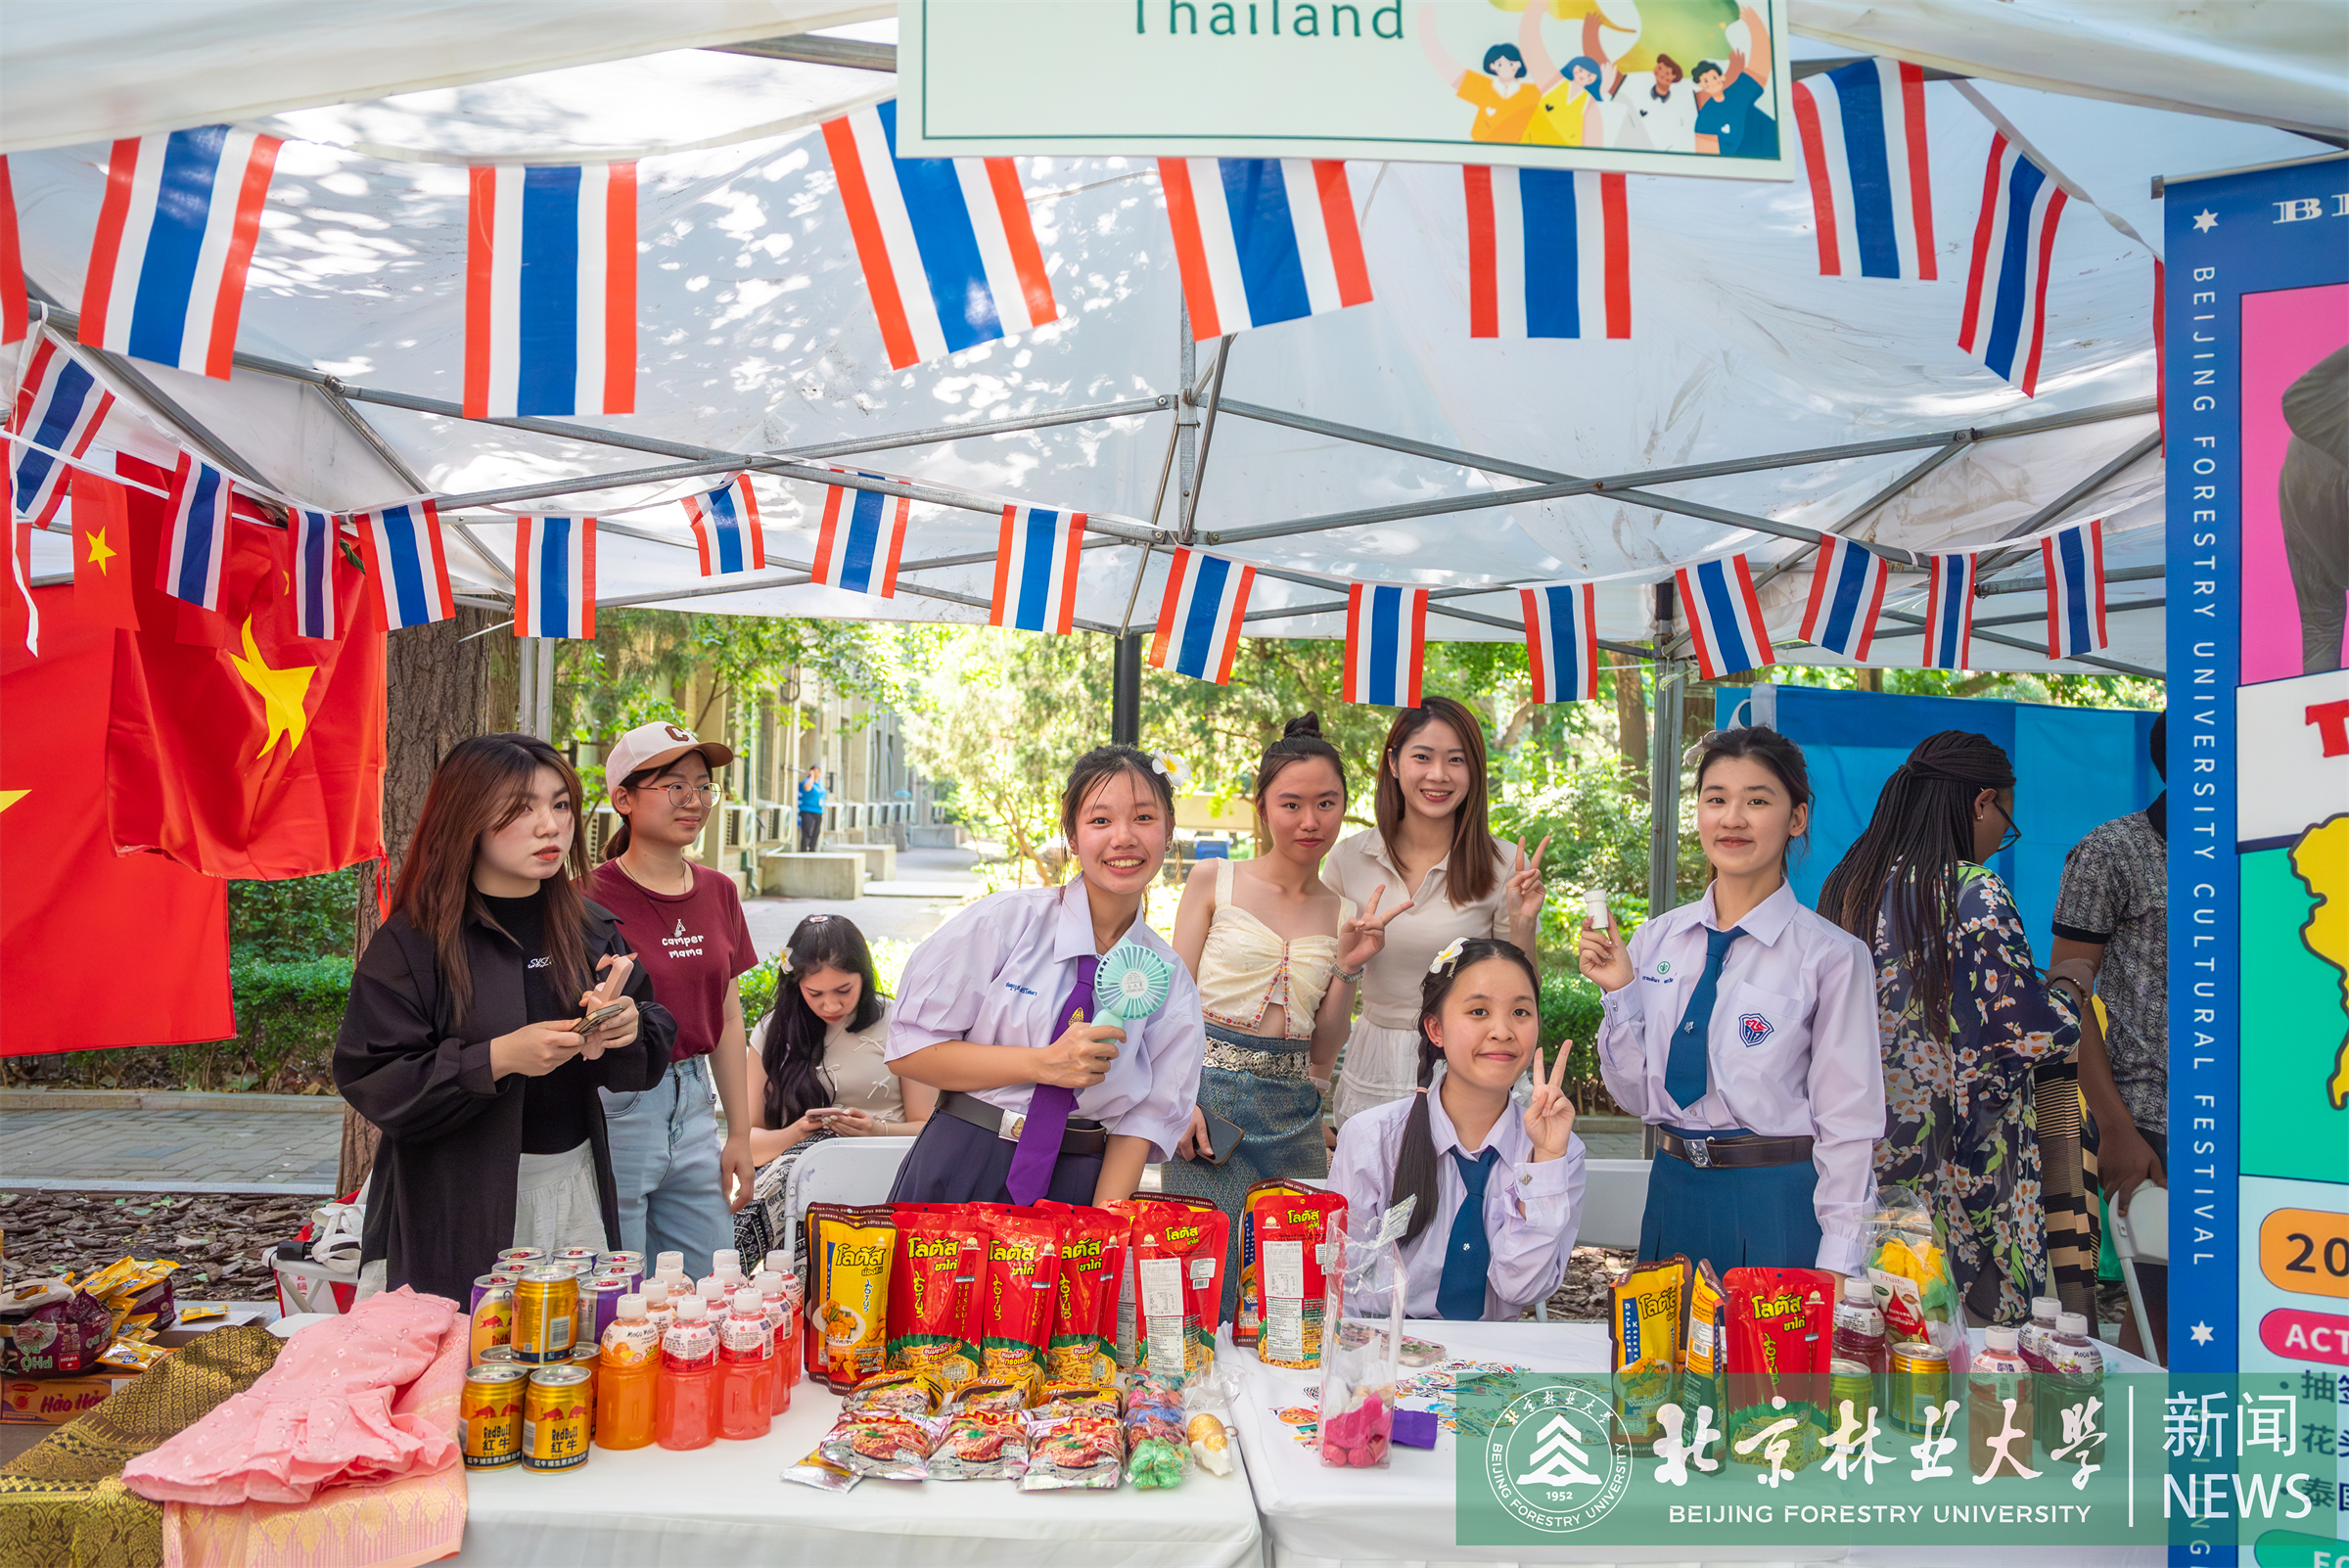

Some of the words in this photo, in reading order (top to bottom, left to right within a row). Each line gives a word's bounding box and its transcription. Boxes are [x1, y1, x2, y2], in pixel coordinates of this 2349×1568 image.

[2192, 266, 2215, 411] BEIJING
[2192, 437, 2215, 619] FORESTRY
[2192, 642, 2215, 860] UNIVERSITY
[662, 935, 705, 946] camper
[668, 947, 703, 959] mama
[2192, 883, 2215, 1070] CULTURAL
[2192, 1095, 2215, 1266] FESTIVAL
[1287, 1208, 1321, 1225] โลตัส
[1165, 1224, 1200, 1243] โลตัส
[836, 1243, 887, 1268] โลตัส
[907, 1236, 960, 1260] โลตัส
[989, 1239, 1038, 1262] โลตัส
[1061, 1237, 1103, 1260] ลตัส
[934, 1259, 959, 1272] ขาไก่
[1011, 1262, 1036, 1276] ขาไก่
[1079, 1258, 1103, 1273] ขาไก่
[1879, 1272, 1906, 1286] Fruits
[1896, 1284, 1916, 1296] Toffee
[954, 1284, 963, 1319] STICK
[960, 1283, 970, 1333] BISCUIT
[1751, 1292, 1803, 1319] โลตัส
[1782, 1314, 1807, 1332] ขาไก่
[40, 1393, 73, 1414] Hảo
[74, 1390, 106, 1411] Hả
[484, 1424, 511, 1439] RedBull
[551, 1426, 578, 1441] RedBull
[483, 1437, 511, 1451] 红牛
[550, 1439, 577, 1453] 红牛
